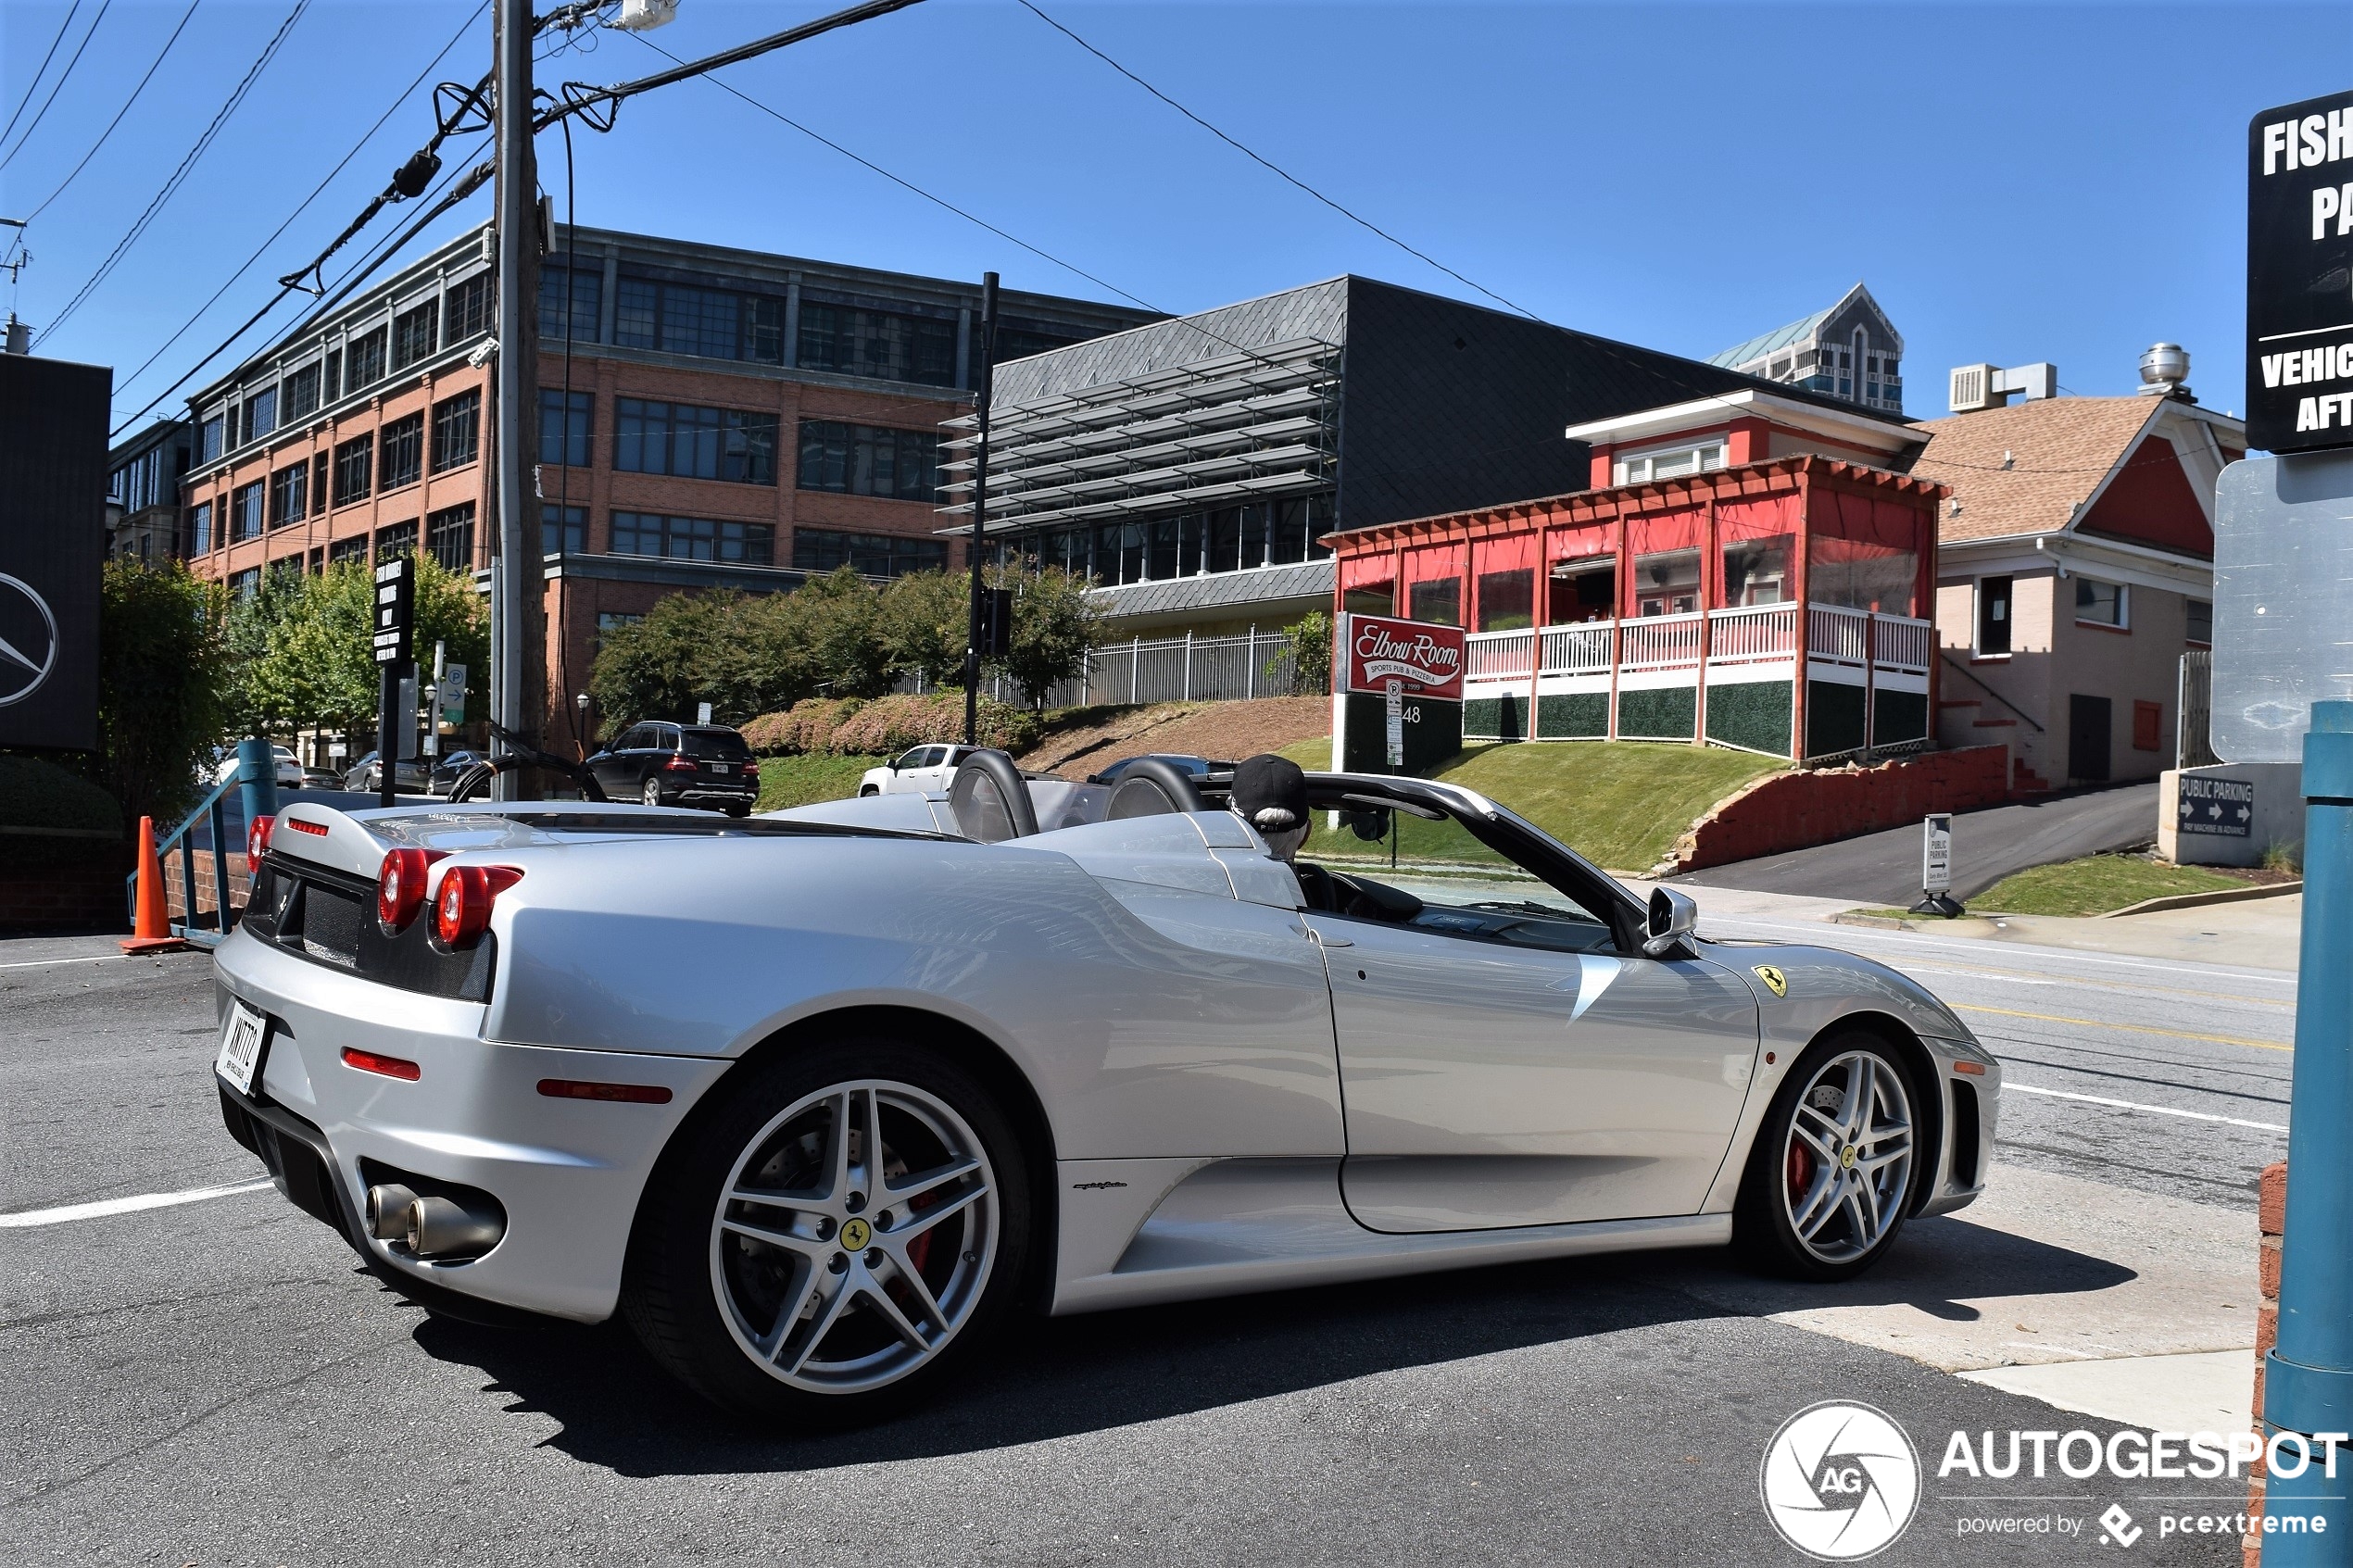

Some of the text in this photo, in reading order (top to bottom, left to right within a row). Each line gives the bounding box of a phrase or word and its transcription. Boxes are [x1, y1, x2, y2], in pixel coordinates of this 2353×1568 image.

[2264, 107, 2353, 176] FISH
[2260, 343, 2353, 388] VEHIC
[2296, 391, 2353, 432] AFT
[1355, 624, 1460, 668] Elbow Room
[1371, 664, 1391, 673] SPORTS
[1393, 665, 1404, 673] PUB
[1412, 669, 1436, 684] PIZZERIA
[2180, 778, 2252, 802] PUBLIC PARKING
[2194, 823, 2216, 833] MACHINE
[2217, 825, 2223, 834] IN
[2223, 826, 2246, 835] ADVANCE
[1930, 849, 1947, 859] PARKING
[1931, 840, 1946, 849] PUBLIC
